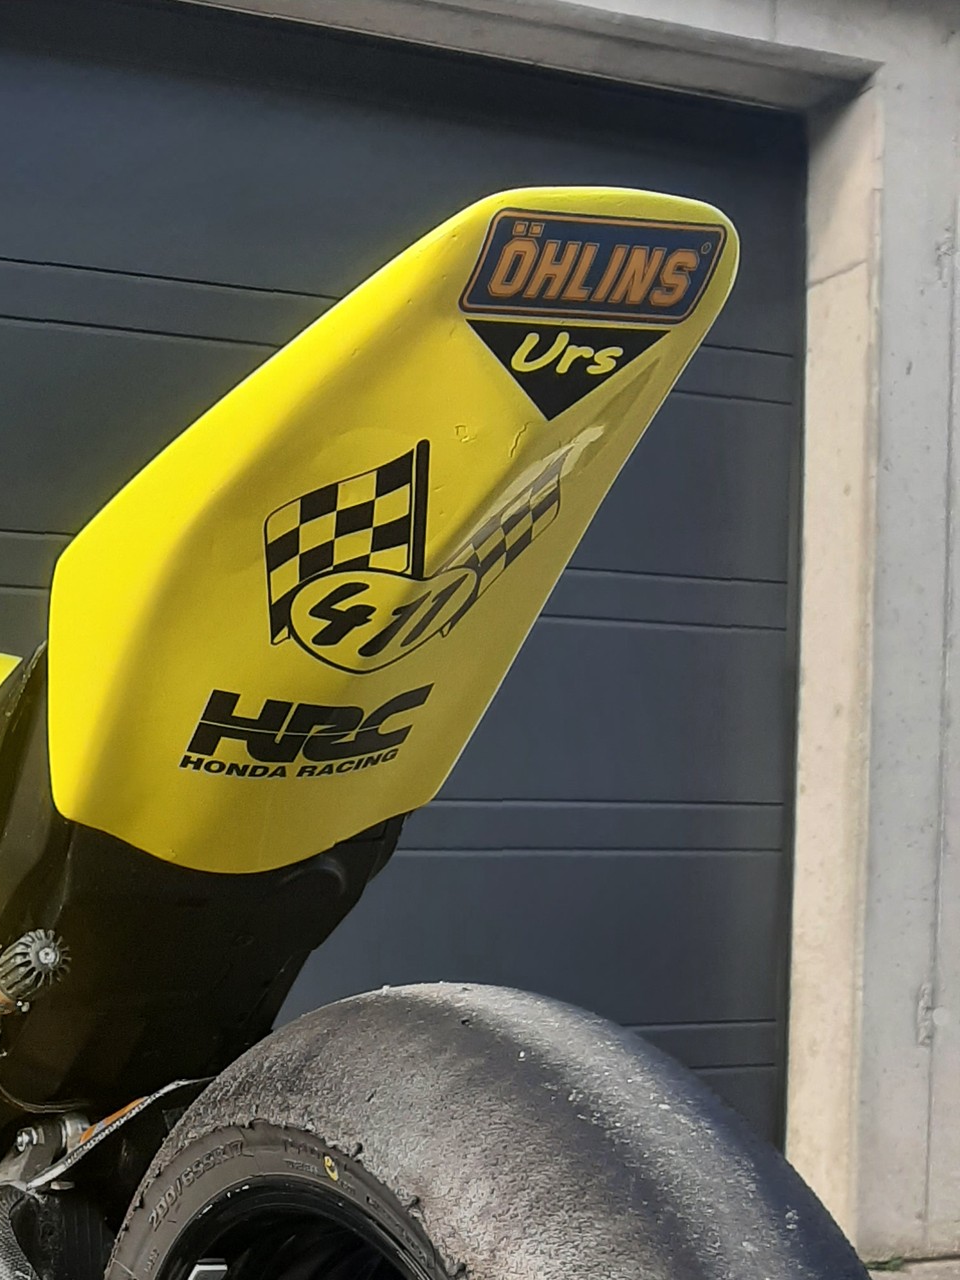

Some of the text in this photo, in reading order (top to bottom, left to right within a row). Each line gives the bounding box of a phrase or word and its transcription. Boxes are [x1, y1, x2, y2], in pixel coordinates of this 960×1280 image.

[511, 332, 624, 375] Urs
[187, 683, 435, 763] HRC
[179, 748, 400, 778] HONDA RACING
